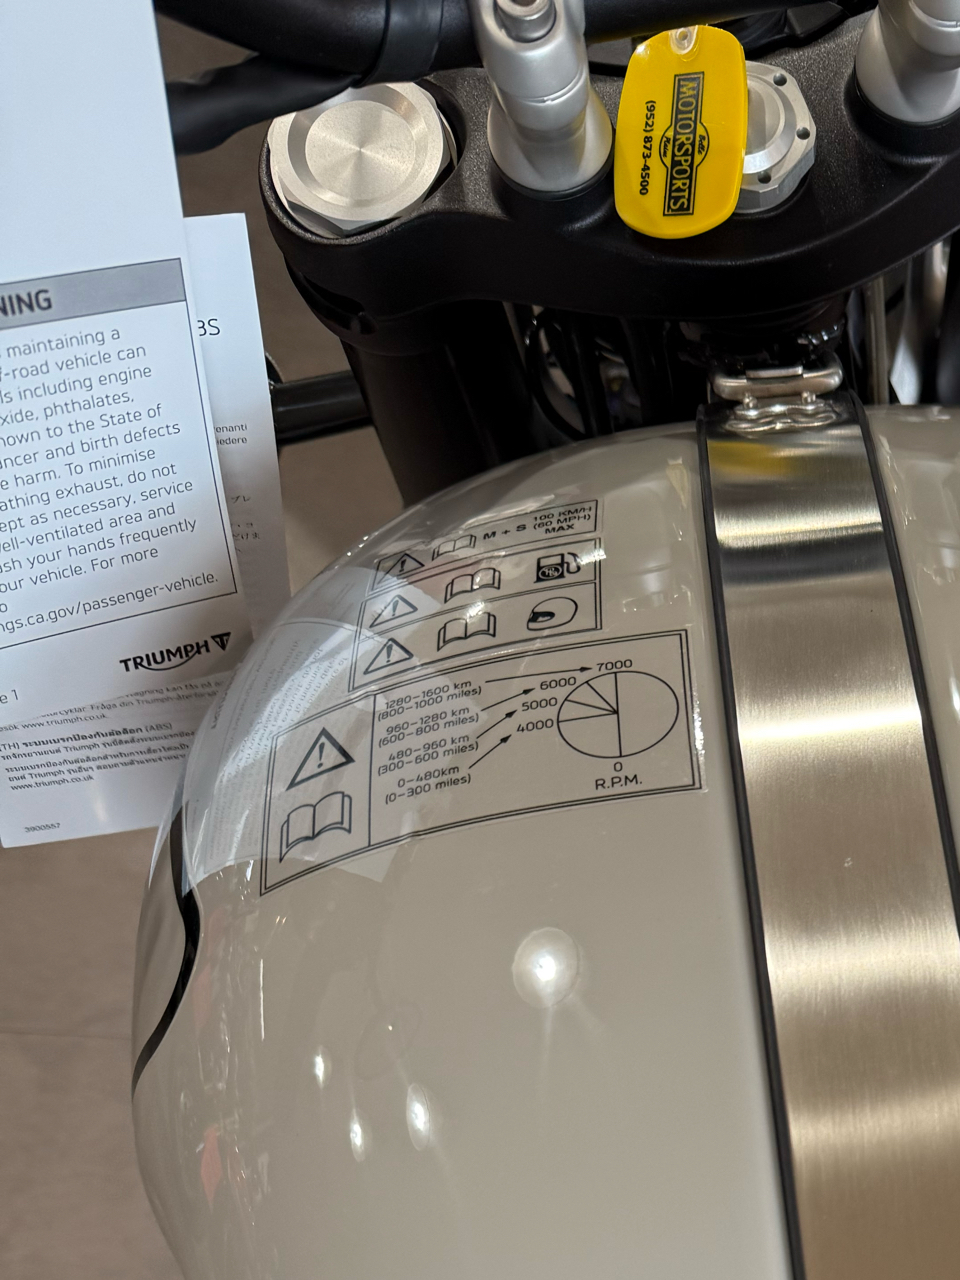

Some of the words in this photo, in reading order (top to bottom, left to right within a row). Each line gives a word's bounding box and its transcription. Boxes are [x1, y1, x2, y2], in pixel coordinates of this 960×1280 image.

[643, 100, 657, 133] (952)
[669, 80, 698, 210] MOTORSPORTS
[639, 135, 653, 196] 873-4500
[6, 328, 105, 358] maintaining
[110, 328, 120, 340] a
[55, 350, 112, 372] vehicle
[116, 345, 147, 361] can
[18, 377, 93, 401] including
[99, 365, 152, 386] engine
[43, 391, 134, 420] phthalates,
[46, 426, 63, 438] to
[67, 417, 95, 434] the
[100, 411, 142, 428] State
[147, 403, 162, 418] of
[45, 442, 75, 459] and
[80, 434, 119, 452] birth
[123, 423, 181, 444] defects
[14, 469, 61, 488] harm.
[65, 462, 84, 477] To
[89, 449, 156, 472] minimise
[55, 475, 123, 499] exhaust,
[127, 470, 146, 484] do
[152, 463, 177, 479] not
[30, 513, 48, 526] as
[53, 494, 136, 521] necessary,
[140, 480, 193, 502] service
[109, 513, 143, 529] area
[147, 501, 176, 520] and
[534, 513, 554, 522] 100
[559, 506, 592, 518] KM/H
[483, 531, 496, 540] M
[516, 524, 527, 532] S
[533, 520, 552, 530] (60
[557, 513, 591, 525] MPH)
[545, 523, 575, 534] MAX
[27, 549, 62, 569] your
[67, 536, 115, 558] hands
[119, 518, 197, 547] frequently
[30, 564, 87, 586] vehicle.
[91, 556, 115, 572] For
[121, 547, 159, 564] more
[119, 640, 210, 672] TRIUMPH
[596, 659, 633, 672] 7000
[453, 680, 472, 691] km
[540, 676, 577, 691] 6000
[11, 689, 19, 701] 1
[446, 686, 482, 702] miles)
[451, 707, 470, 718] km
[521, 696, 558, 712] 5000
[443, 713, 480, 729] miles)
[516, 718, 554, 733] 4000
[63, 741, 100, 754] Triumph
[451, 734, 470, 746] km
[443, 741, 479, 757] miles)
[28, 768, 65, 781] Triumph
[613, 761, 623, 772] 0
[434, 773, 472, 790] miles)
[595, 774, 643, 790] R.P.M.
